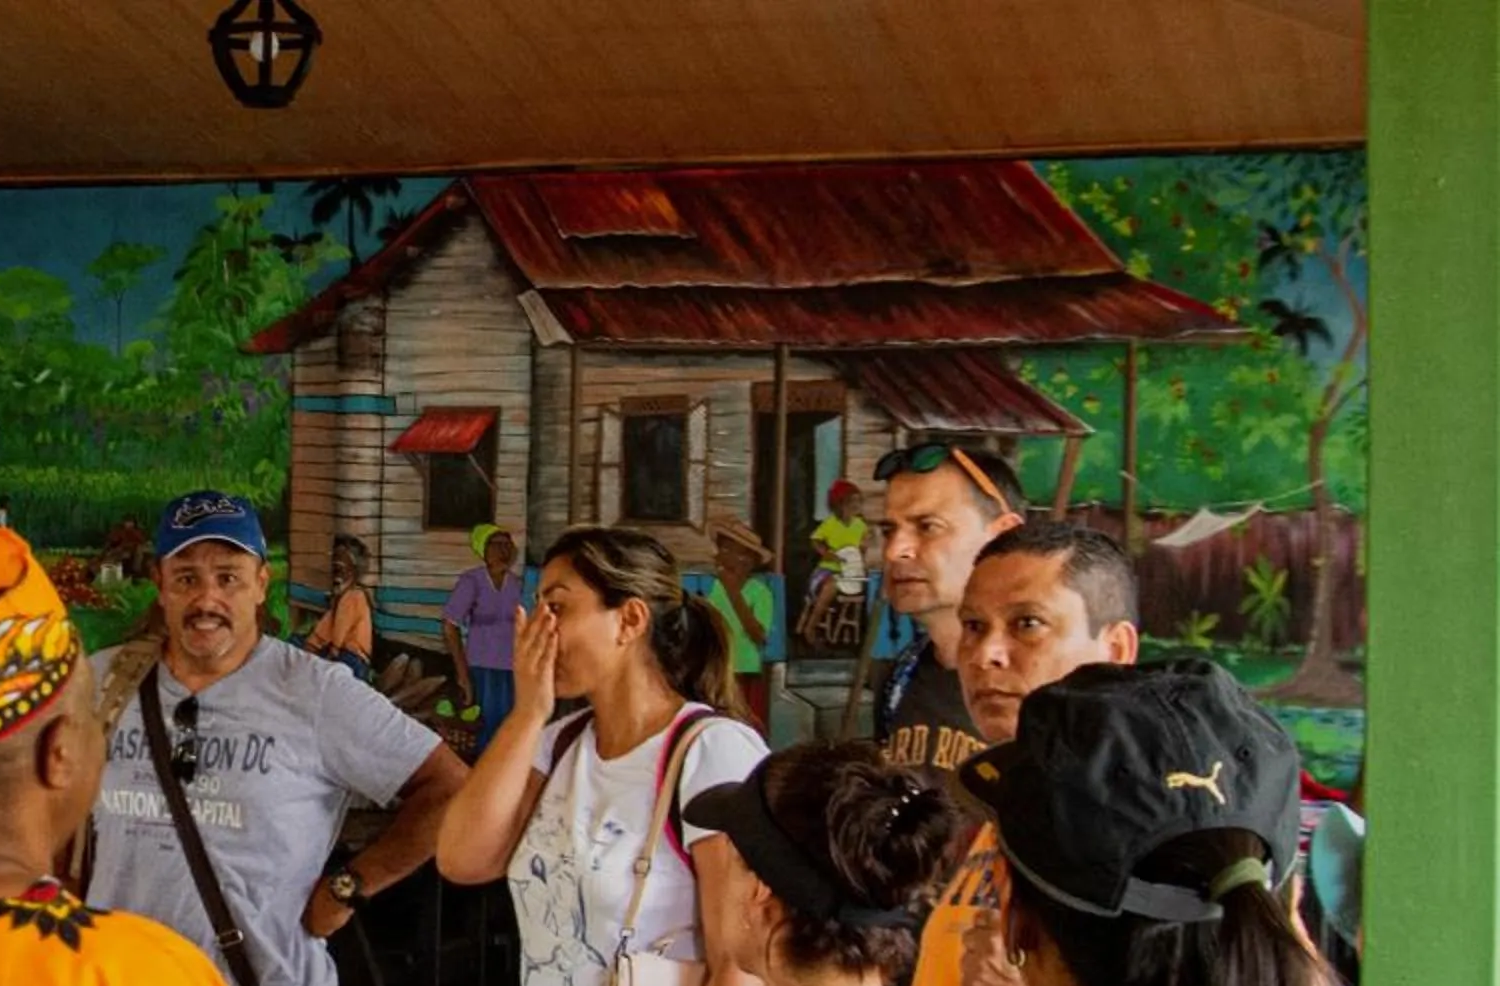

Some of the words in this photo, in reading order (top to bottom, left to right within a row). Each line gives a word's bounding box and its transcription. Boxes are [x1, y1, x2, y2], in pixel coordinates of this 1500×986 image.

[242, 733, 275, 775] DC
[932, 726, 987, 771] ROC
[185, 797, 242, 830] APITAL
